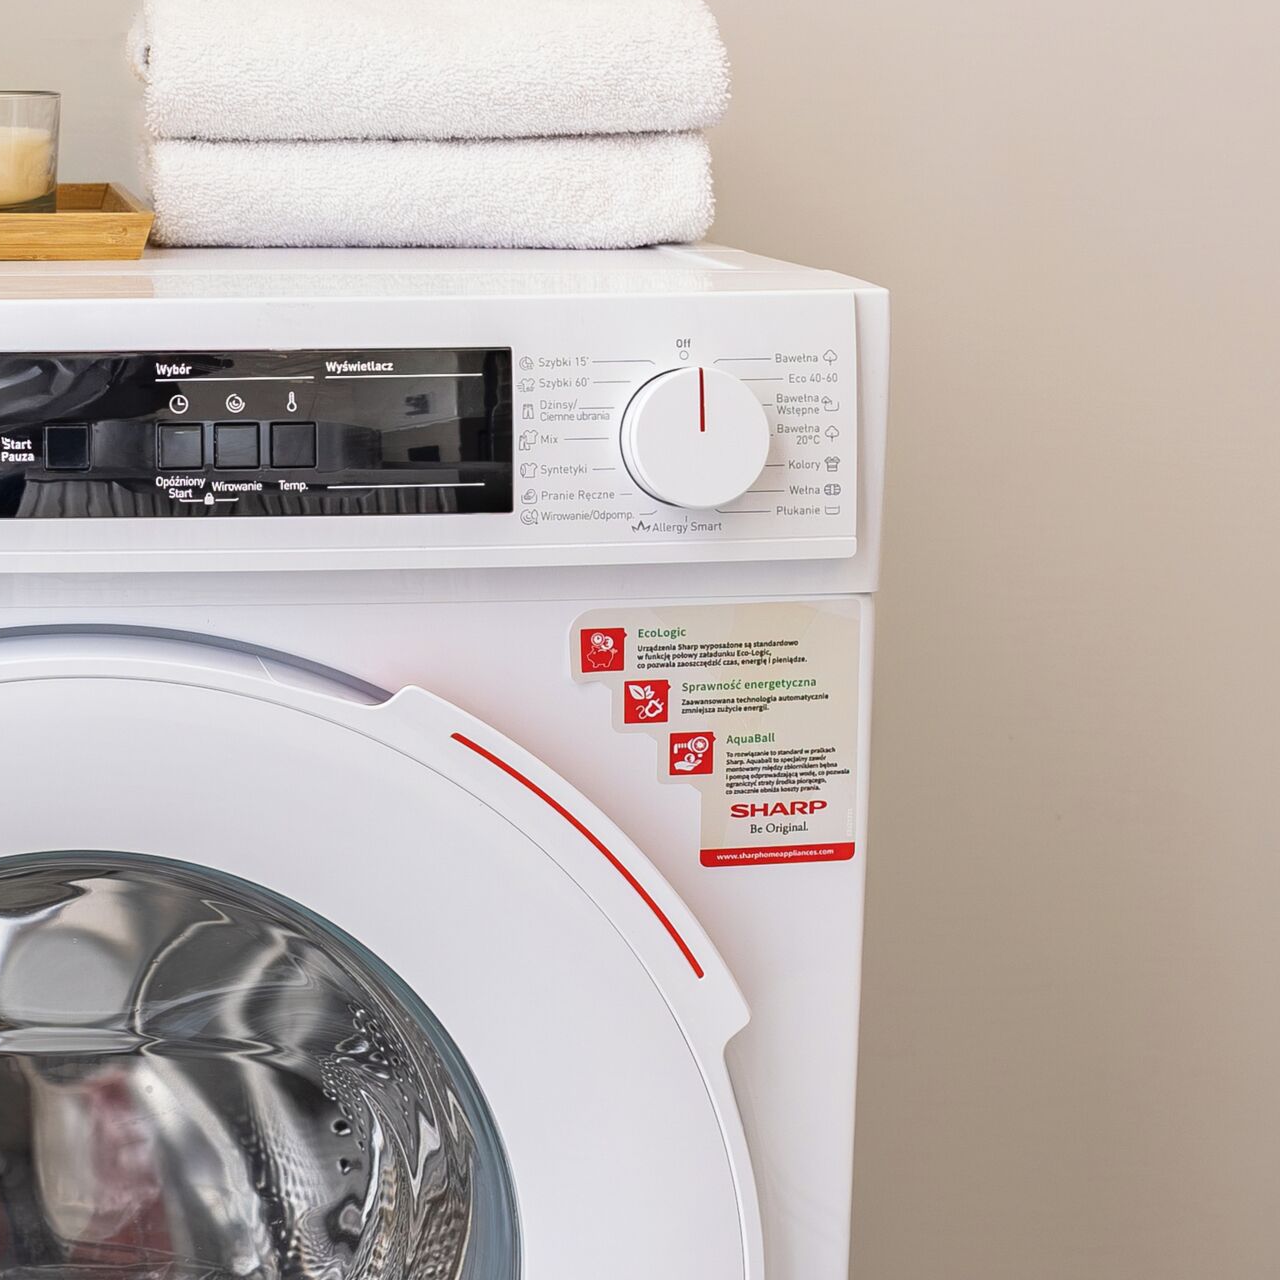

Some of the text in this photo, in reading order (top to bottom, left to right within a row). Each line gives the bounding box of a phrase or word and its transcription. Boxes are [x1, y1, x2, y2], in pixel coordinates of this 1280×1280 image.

[676, 338, 691, 348] Off
[539, 357, 571, 369] Szybki
[776, 353, 819, 363] Bawełna
[156, 363, 192, 377] Wybór
[326, 361, 394, 374] Wyświetlacz
[540, 378, 572, 390] Szybki
[789, 373, 838, 384] Eco 40-60
[777, 394, 820, 403] Bawełna
[540, 411, 610, 422] Ciemne ubrania
[777, 406, 820, 417] Wstępne
[777, 424, 820, 433] Bawełna
[1, 437, 32, 451] Start
[541, 435, 559, 444] Mix
[1, 452, 35, 462] Pauza
[541, 465, 588, 477] Syntetyki
[789, 460, 821, 472] Kolory
[156, 477, 206, 489] Opóźniony
[212, 481, 263, 492] Wirowanie
[279, 480, 309, 493] Temp.
[169, 488, 193, 499] Start
[541, 490, 615, 501] Pranie Ręczne
[790, 485, 821, 495] Wełna
[541, 510, 635, 522] Wirowanie/Odpomp.
[777, 506, 821, 516] Płukanie
[652, 522, 722, 534] Allergy Smart
[638, 627, 687, 640] EcoLogic
[638, 644, 677, 653] Urządzenia
[678, 644, 699, 652] Sharp
[700, 642, 743, 651] wyposażone
[754, 640, 799, 648] standardowo
[645, 653, 671, 661] funkcję
[672, 652, 698, 661] połowy
[737, 649, 772, 657] Eco-Logic,
[647, 661, 676, 670] pozwala
[677, 659, 722, 668] zaoszczędzić
[741, 657, 767, 666] energię
[772, 656, 808, 665] pieniądze.
[682, 678, 817, 694] Sprawność energetyczna
[682, 693, 829, 706] Zaawansowana technologia automatycznie
[681, 704, 770, 715] zmniejsza zużycie energii.
[726, 732, 775, 746] AquaBall
[730, 800, 828, 818] SHARP
[750, 821, 809, 835] Be Original.
[716, 848, 835, 861] www.sharphomeappliances.com
